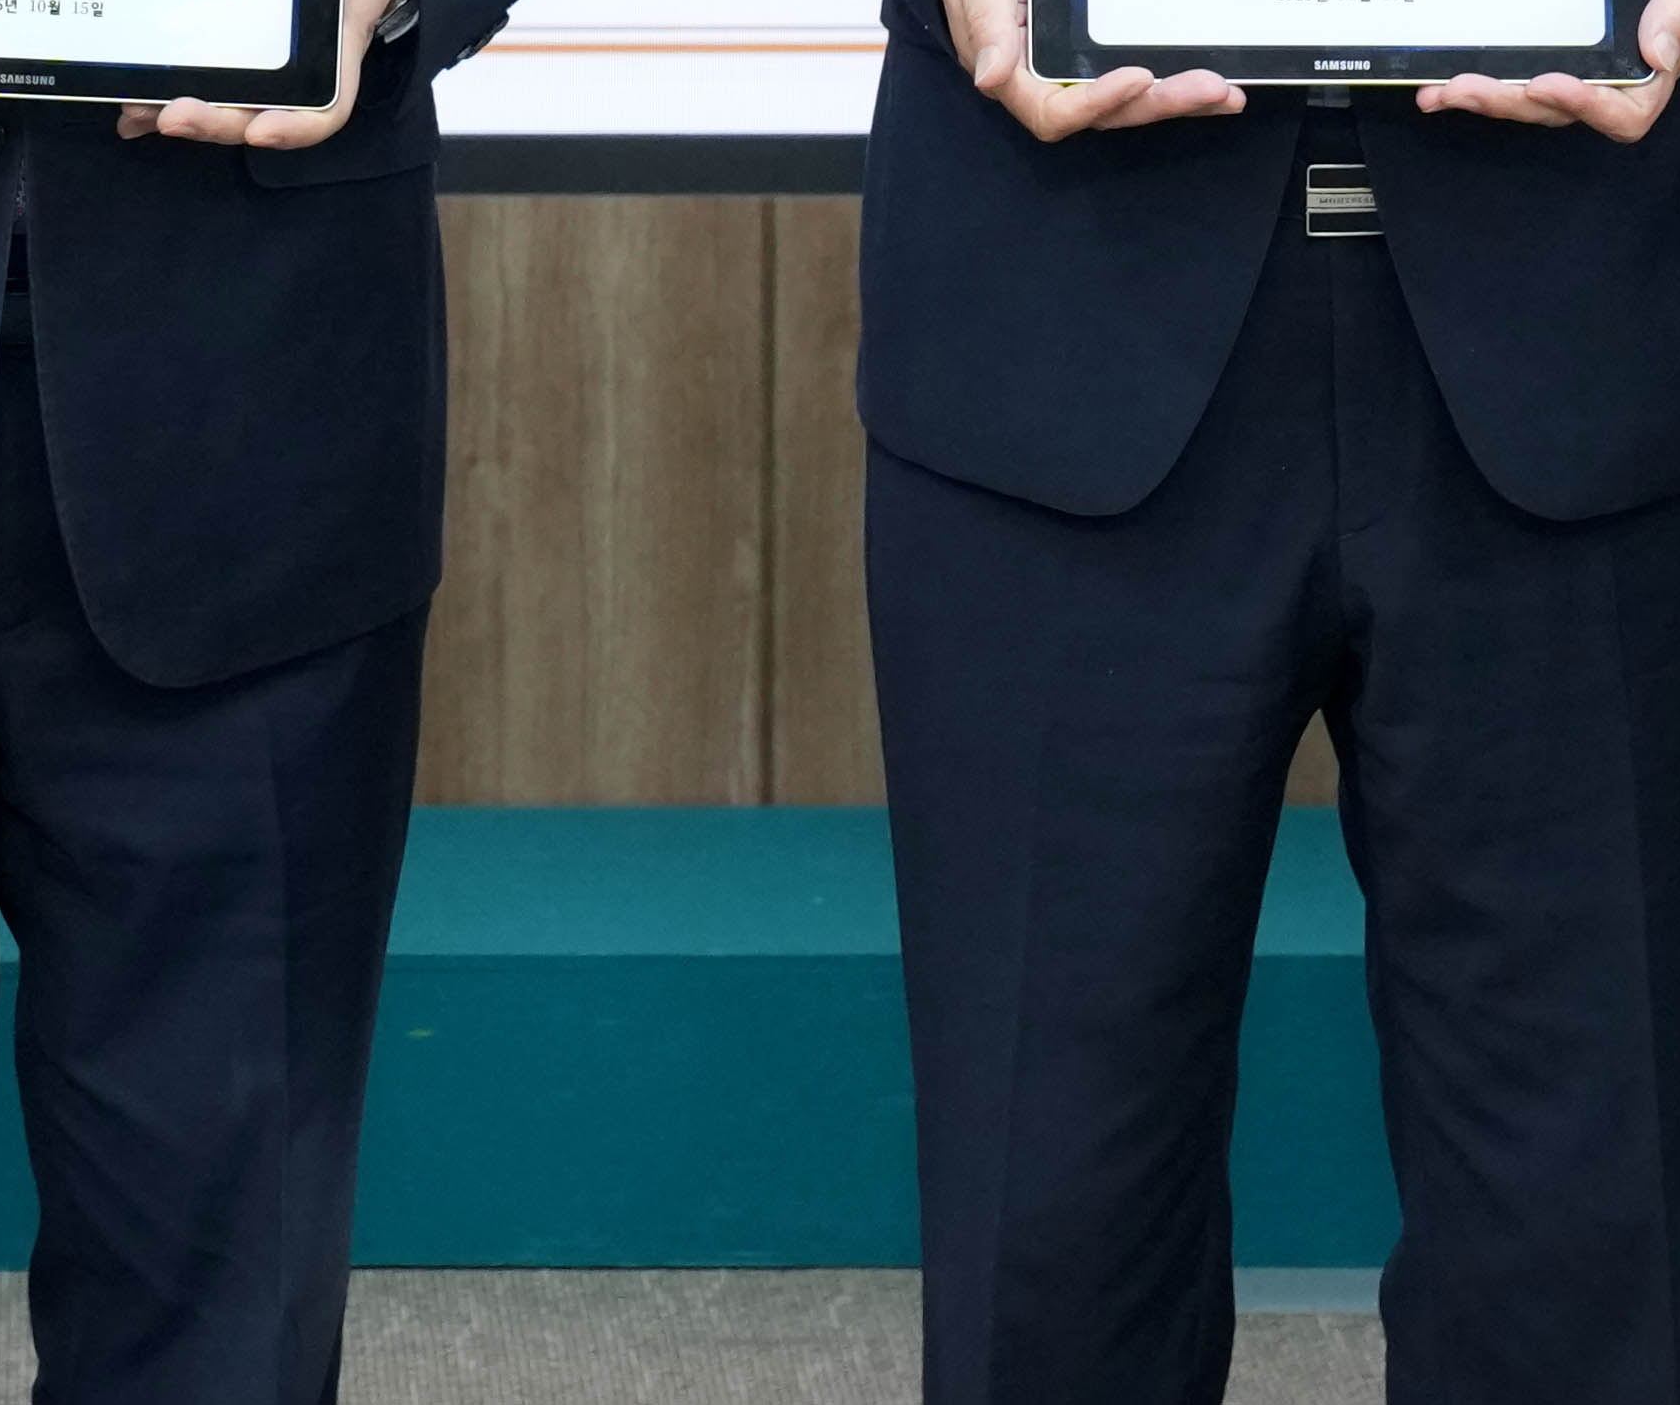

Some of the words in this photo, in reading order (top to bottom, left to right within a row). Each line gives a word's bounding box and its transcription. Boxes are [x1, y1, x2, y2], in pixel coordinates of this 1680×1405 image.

[29, 0, 61, 16] 10월
[72, 1, 104, 18] 15일
[1313, 60, 1371, 71] SAMSUNG
[0, 73, 56, 86] SAMSUNG
